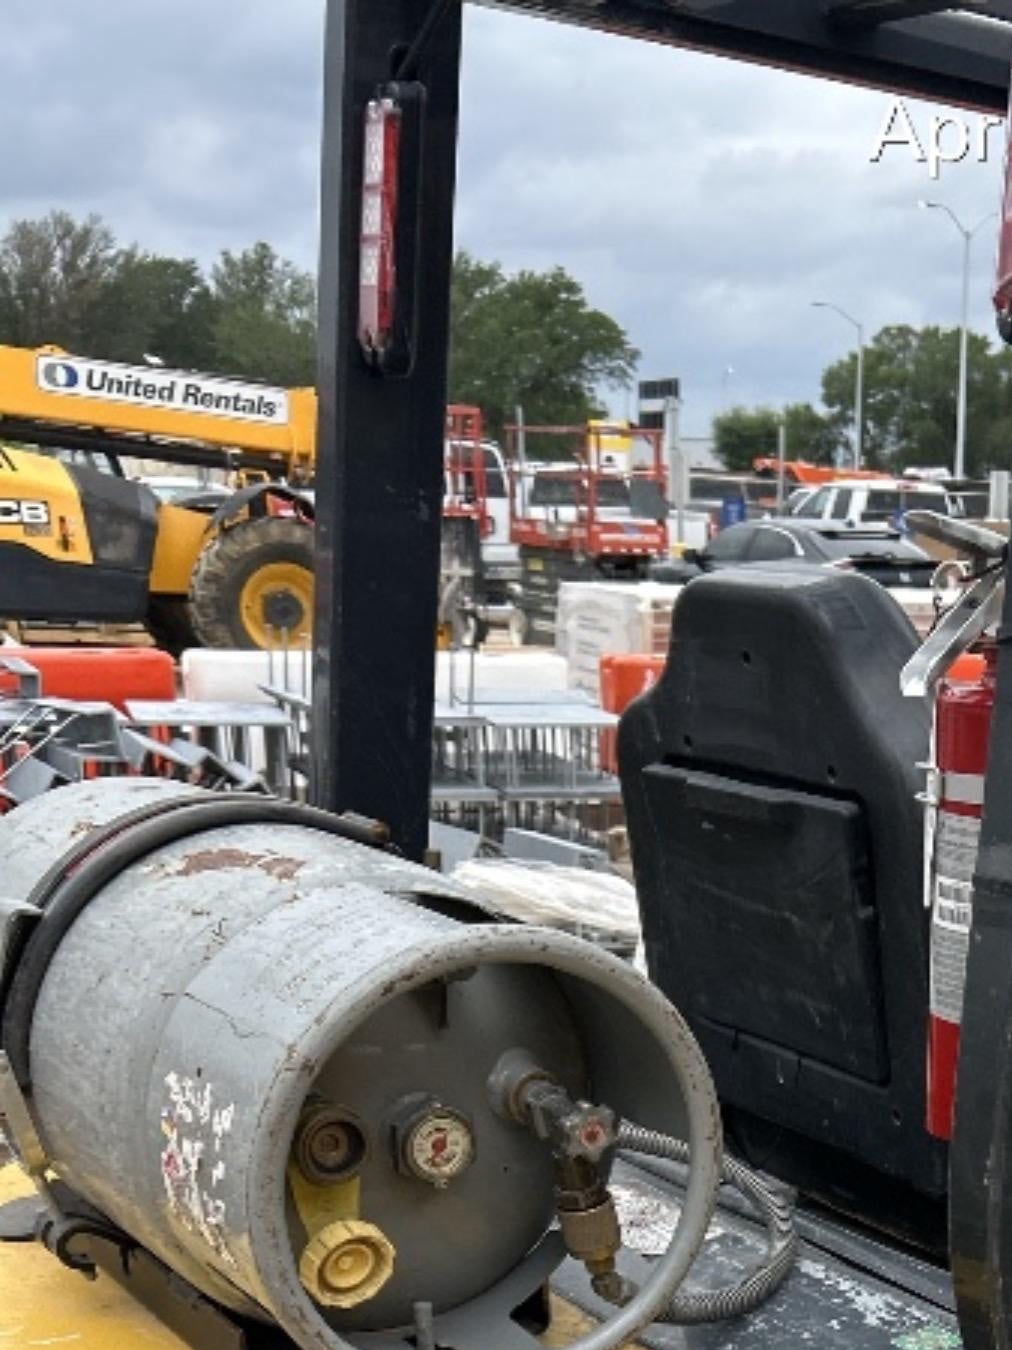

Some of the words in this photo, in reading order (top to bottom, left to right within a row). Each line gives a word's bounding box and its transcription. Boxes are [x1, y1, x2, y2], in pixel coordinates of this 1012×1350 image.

[86, 368, 175, 402] United
[182, 382, 277, 418] Rentals
[0, 500, 49, 524] CB
